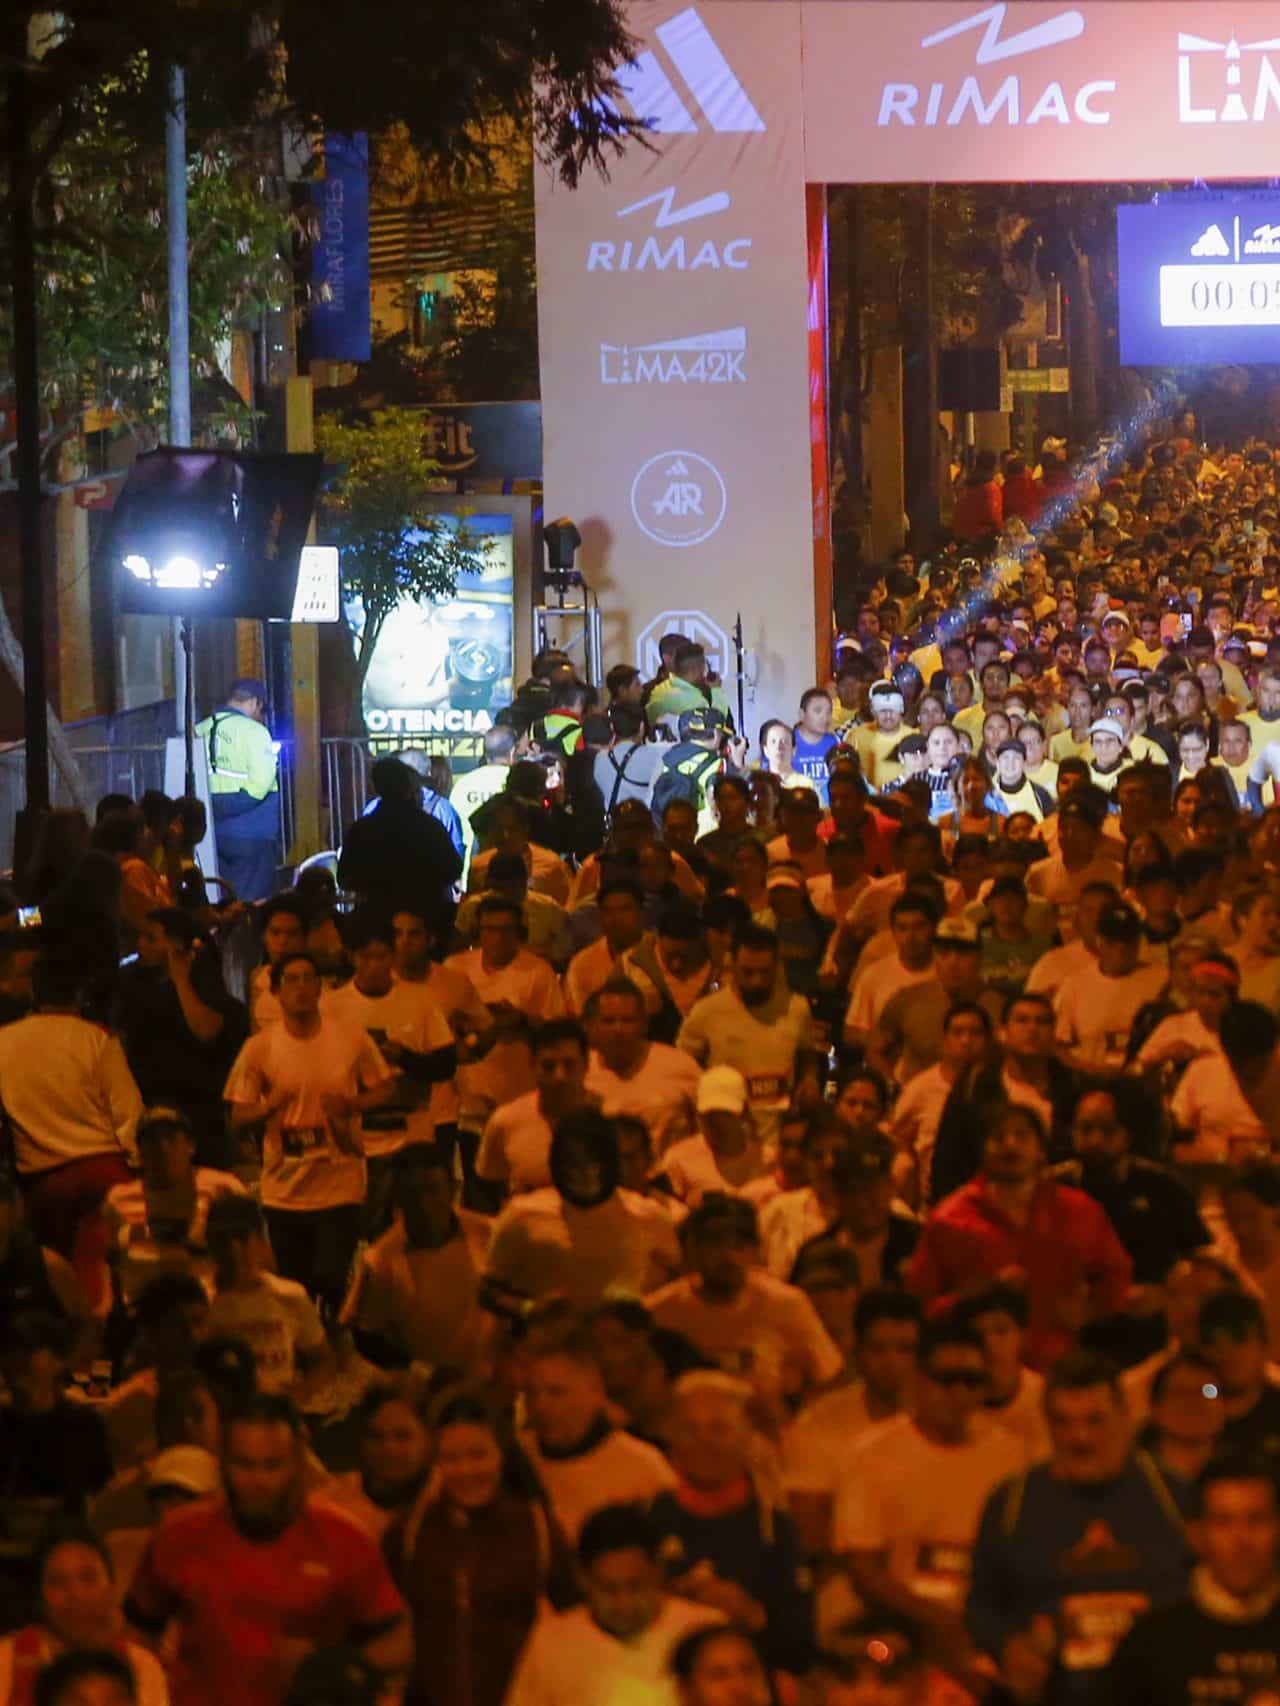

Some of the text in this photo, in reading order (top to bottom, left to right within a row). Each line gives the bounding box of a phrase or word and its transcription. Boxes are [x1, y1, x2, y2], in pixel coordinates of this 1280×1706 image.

[876, 75, 1117, 127] RIMAC
[586, 235, 753, 272] RIMAC
[364, 709, 494, 733] OTENCIA
